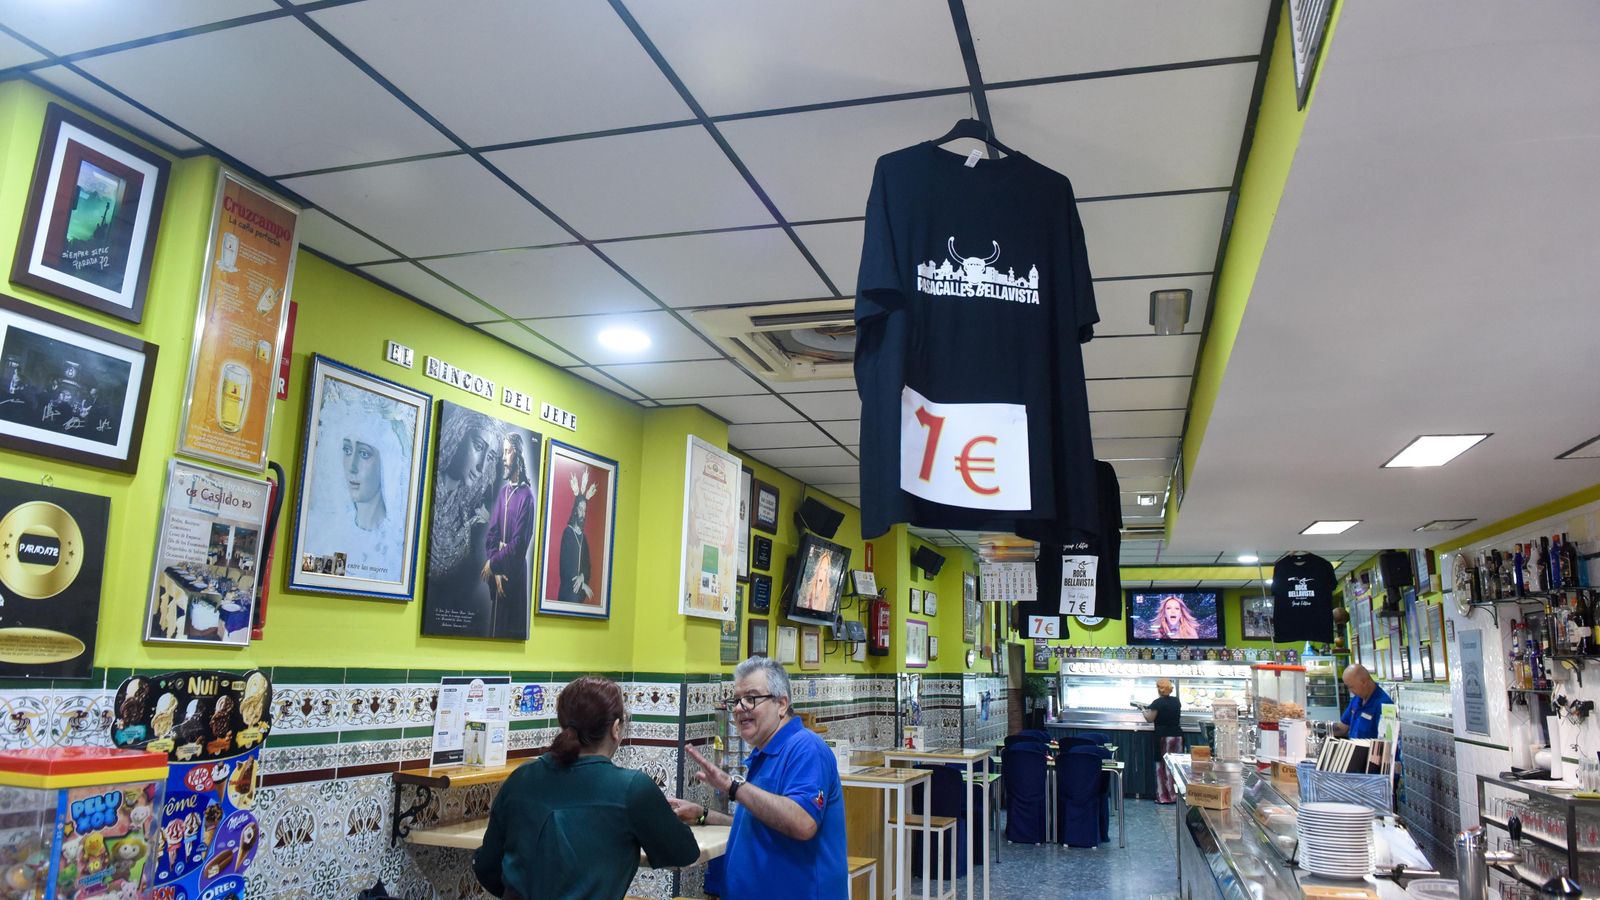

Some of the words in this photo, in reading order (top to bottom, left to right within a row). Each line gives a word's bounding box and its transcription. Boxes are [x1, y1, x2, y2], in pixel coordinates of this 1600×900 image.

[224, 196, 291, 241] Cruzcampo
[917, 276, 976, 298] PASACALLES
[976, 282, 1040, 304] BELLAVISTA
[390, 343, 412, 367] EL
[428, 358, 494, 398] RINCON
[505, 389, 530, 412] DEL
[543, 405, 576, 429] JEFE
[954, 434, 1000, 495] €
[201, 488, 240, 508] Casildo
[1064, 578, 1094, 587] BELLAVISTA
[1072, 570, 1086, 578] ROCK
[1069, 601, 1076, 613] 7
[1078, 601, 1086, 614] €
[1034, 618, 1043, 634] 7
[1044, 622, 1054, 636] €
[1188, 788, 1218, 800] Cruzcampo
[72, 790, 122, 820] PELU
[202, 881, 236, 900] OREO
